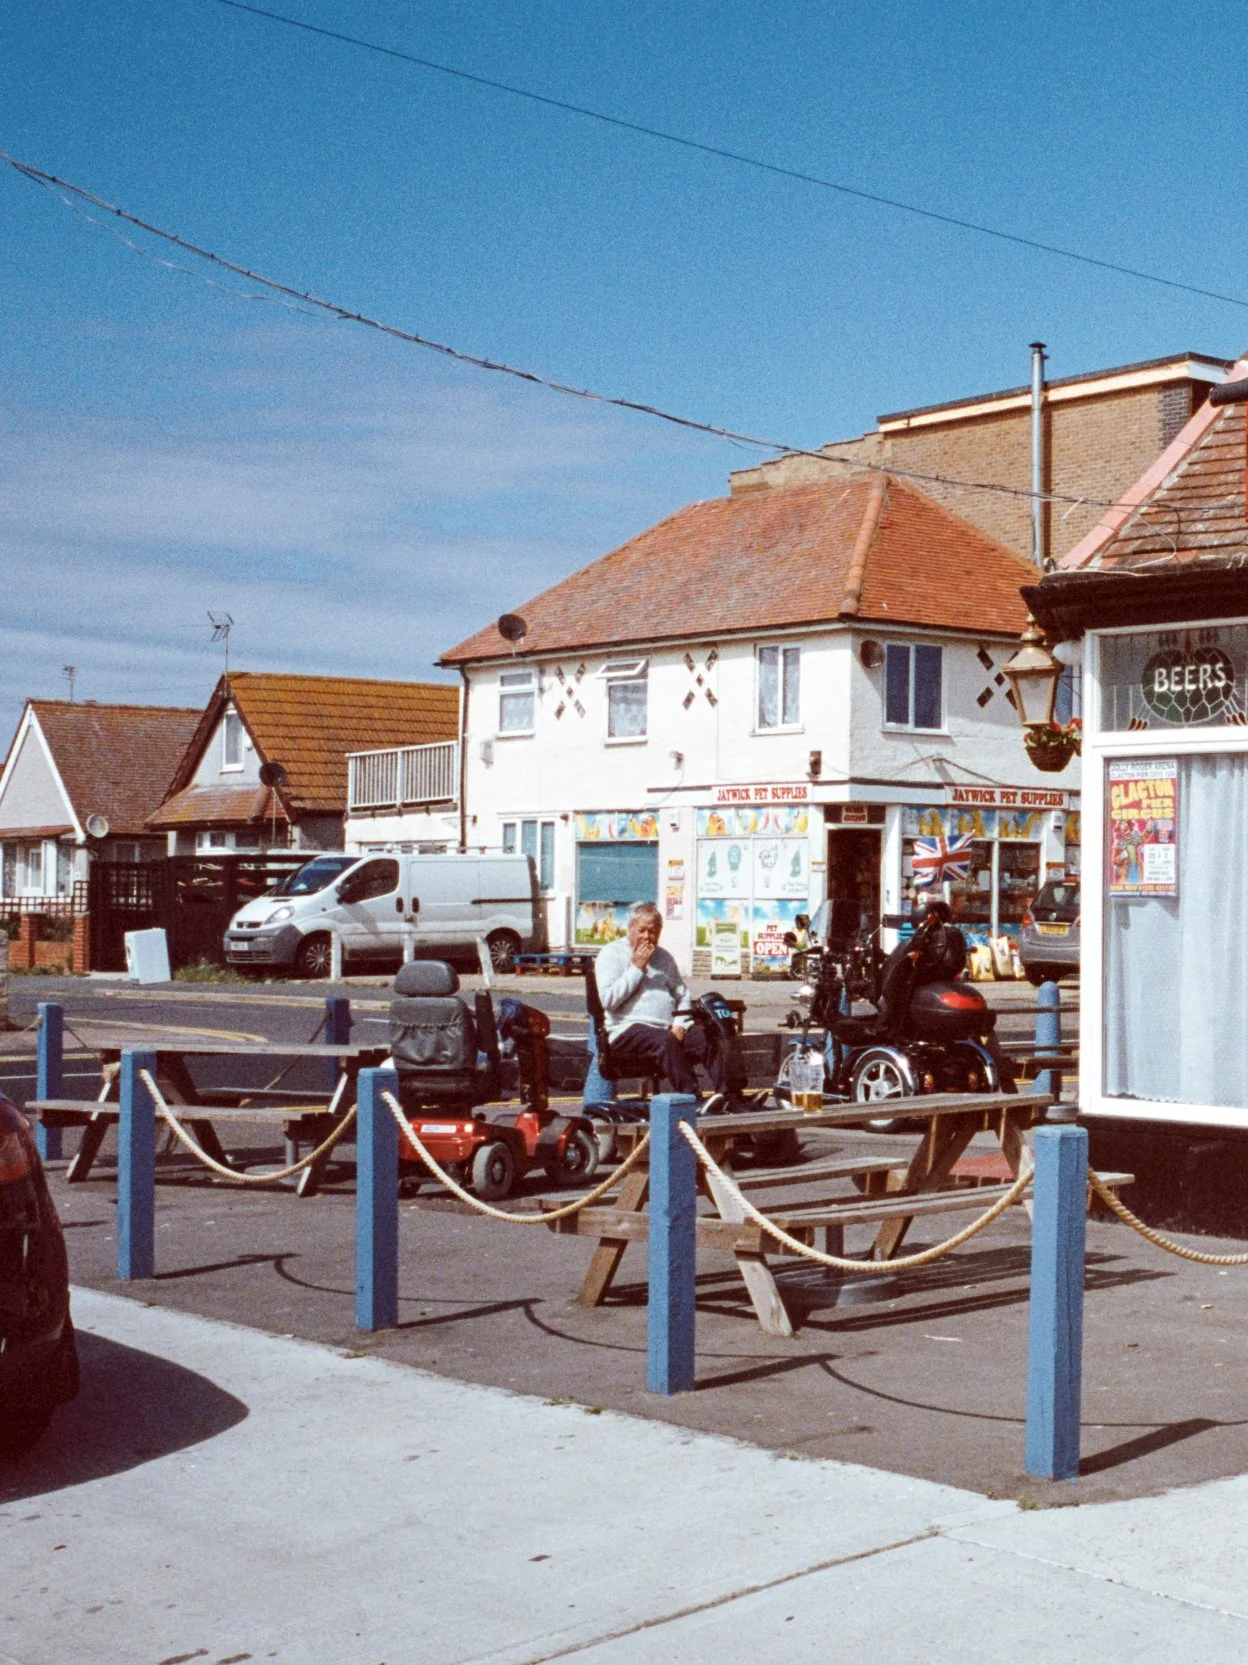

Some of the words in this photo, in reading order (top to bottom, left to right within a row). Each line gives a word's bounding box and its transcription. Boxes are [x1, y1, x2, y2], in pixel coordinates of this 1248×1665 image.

[1154, 662, 1227, 692] BEERS
[717, 788, 751, 802] JAYWICK
[754, 788, 768, 800] PET
[771, 787, 807, 800] SUPPLIES
[952, 789, 996, 803] JAYWICK
[1000, 791, 1018, 803] PET
[1021, 792, 1063, 805] SUPPLIES
[1111, 779, 1174, 809] CLACTON
[1111, 808, 1174, 820] CIRCUS
[766, 924, 778, 932] PET
[755, 941, 788, 955] OPEN
